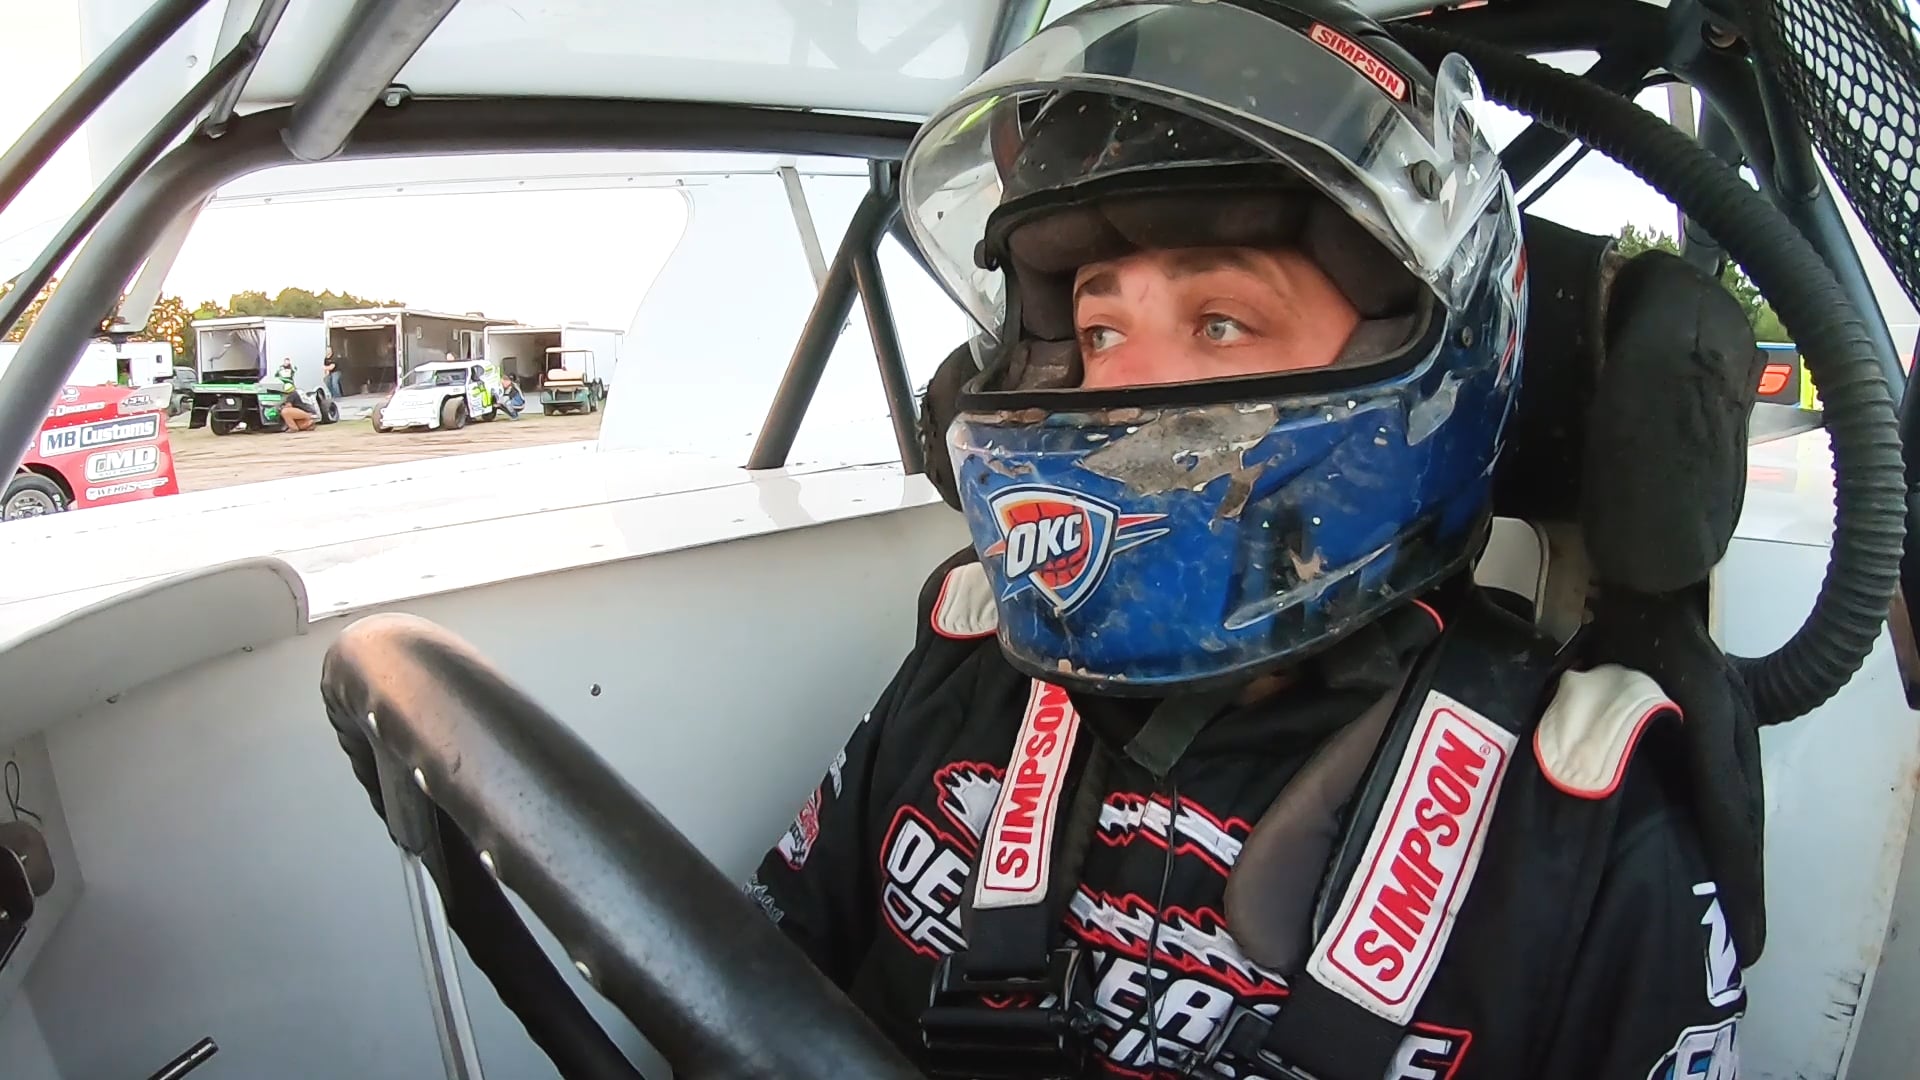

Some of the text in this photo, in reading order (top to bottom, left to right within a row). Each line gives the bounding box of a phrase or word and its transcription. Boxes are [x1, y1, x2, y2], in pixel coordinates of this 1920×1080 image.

[1317, 29, 1399, 93] SIMPSON
[47, 421, 154, 450] MB Customs
[1007, 513, 1083, 578] OKC
[996, 682, 1070, 879] SIMPSON
[1354, 728, 1487, 982] SIMPSON
